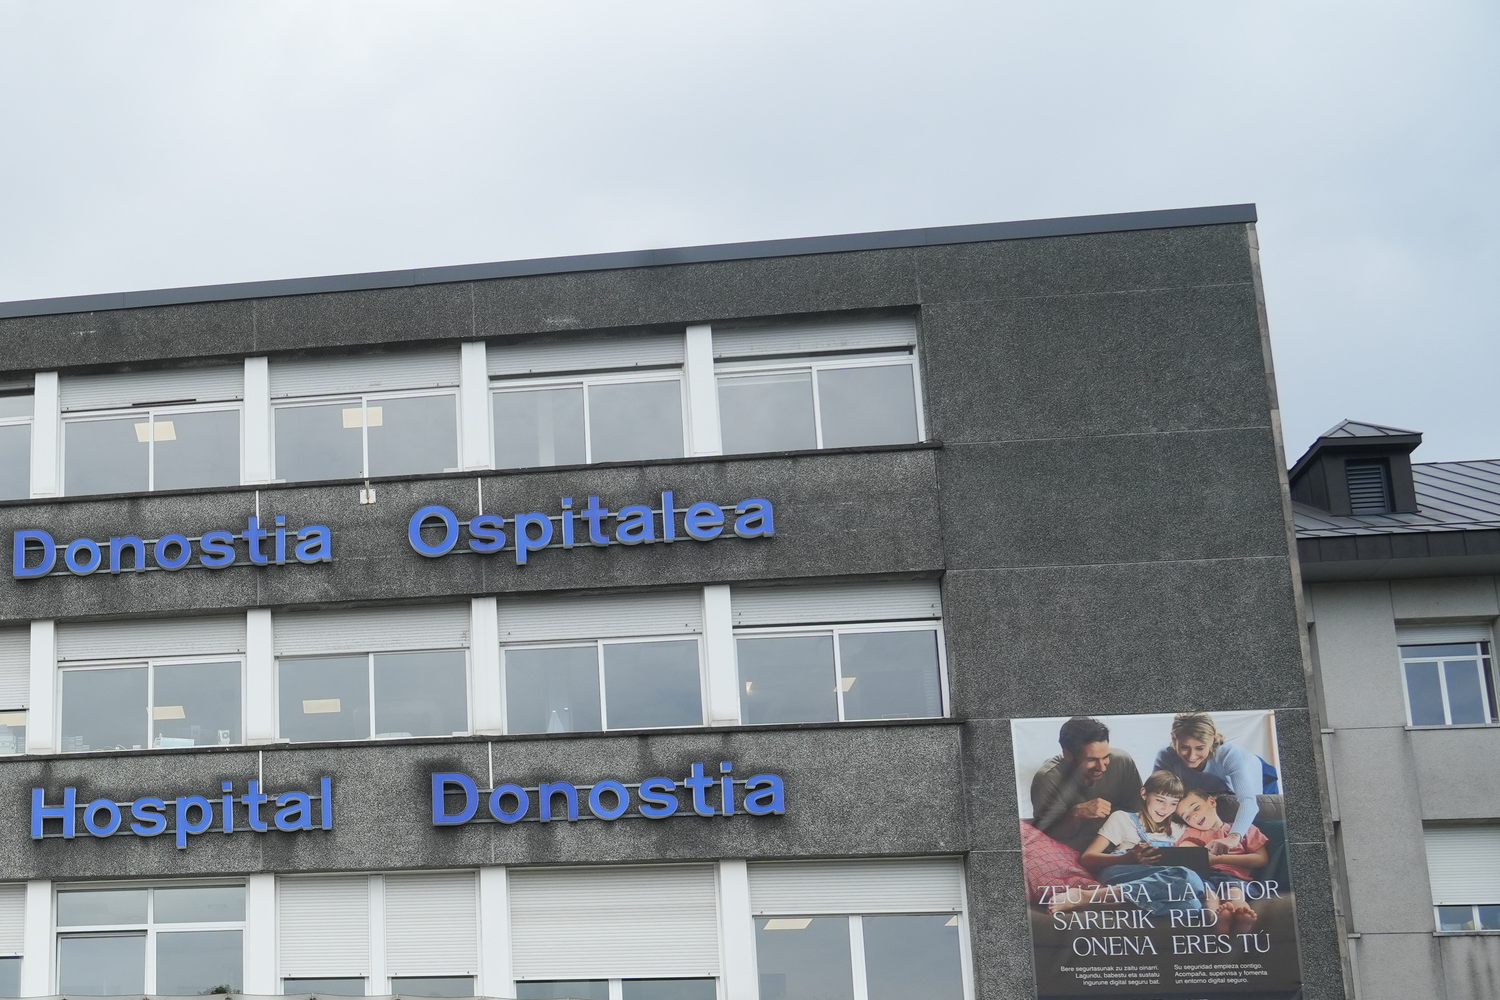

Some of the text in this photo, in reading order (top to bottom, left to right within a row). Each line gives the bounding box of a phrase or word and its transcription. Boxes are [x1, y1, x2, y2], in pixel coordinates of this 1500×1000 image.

[13, 490, 775, 580] Donostia Ospitalea
[30, 760, 786, 849] Hospital Donostia
[1037, 883, 1153, 905] ZEU ZARA
[1167, 880, 1283, 902] LA MEJOR
[1053, 909, 1155, 931] SARERIK
[1170, 908, 1218, 928] RED
[1072, 936, 1158, 956] ONENA
[1172, 930, 1271, 955] ERES TÚ
